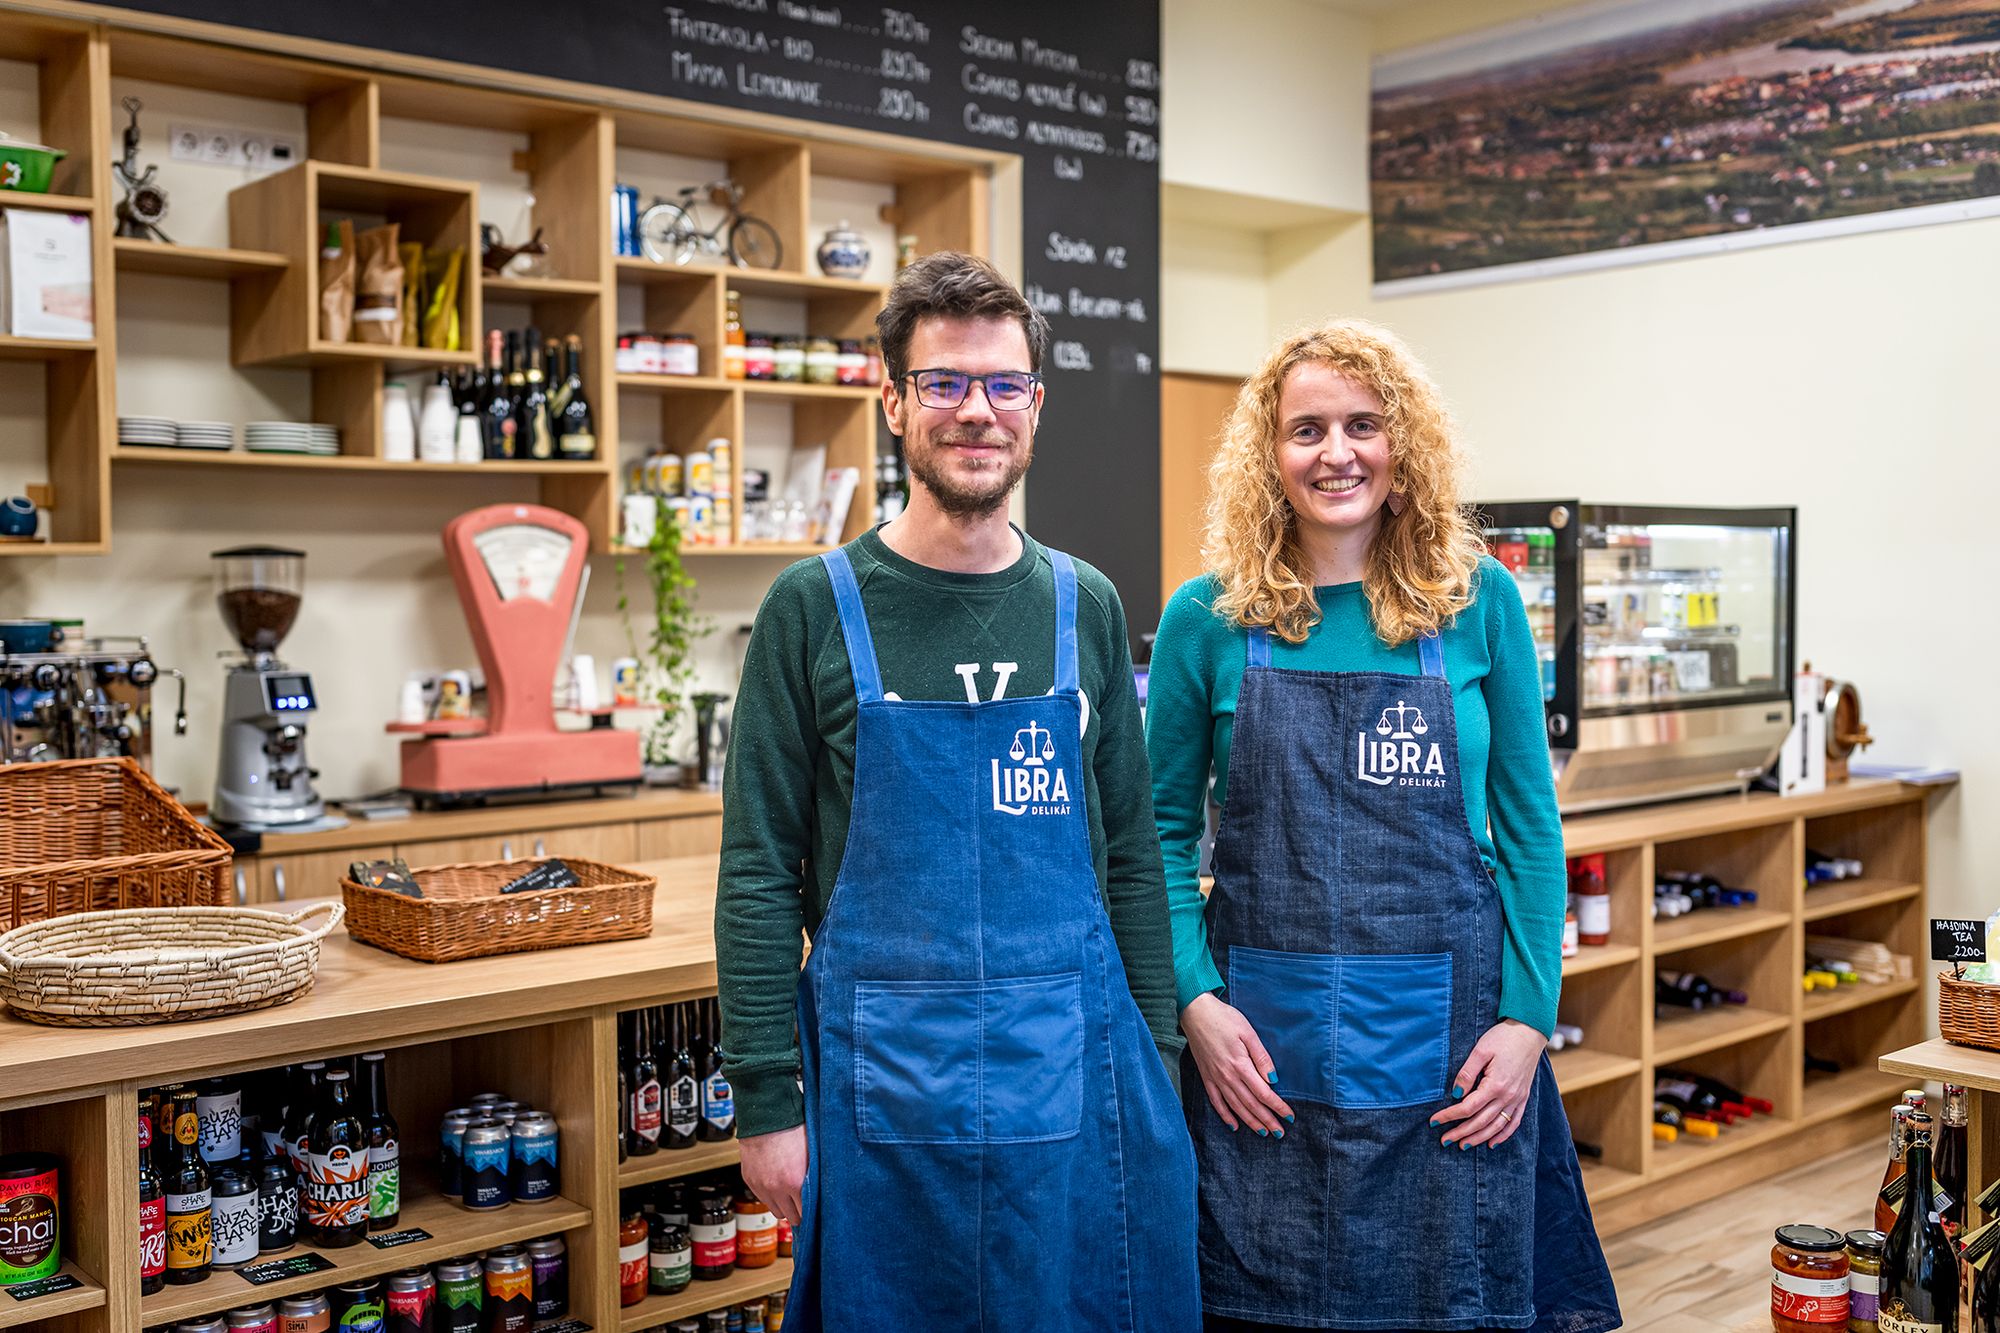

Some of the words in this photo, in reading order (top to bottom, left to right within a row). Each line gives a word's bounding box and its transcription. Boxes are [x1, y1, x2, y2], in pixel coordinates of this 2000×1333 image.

[1358, 732, 1446, 785] LIBRA
[991, 759, 1070, 816] LIBRA
[1399, 776, 1446, 788] DELIKÁT
[1031, 803, 1071, 815] DELIKÁT
[1952, 932, 1974, 943] TEA
[0, 1213, 54, 1245] chai
